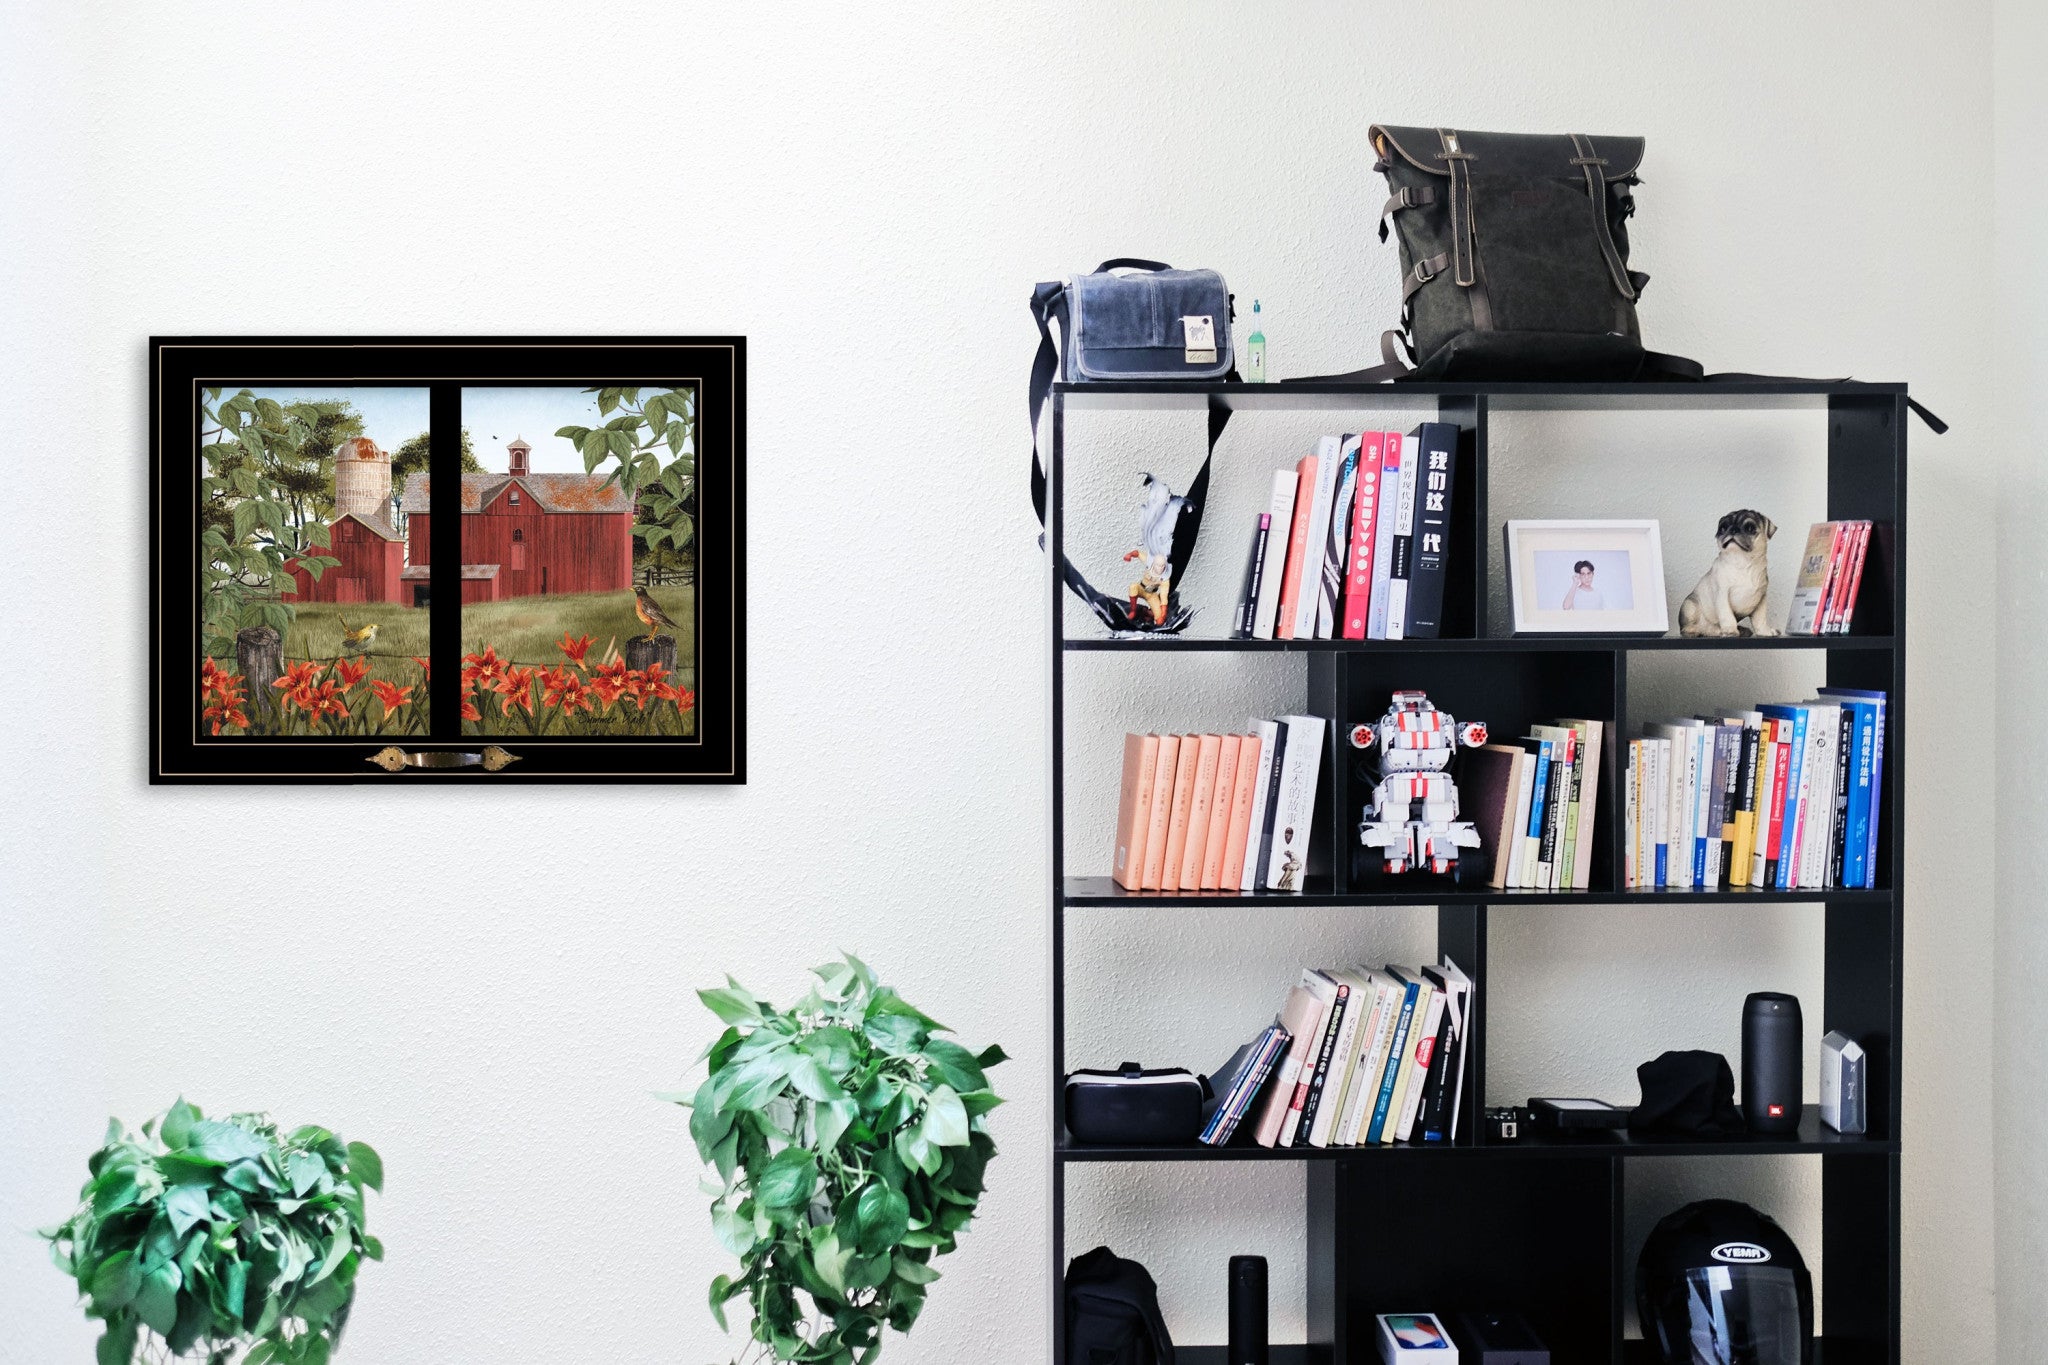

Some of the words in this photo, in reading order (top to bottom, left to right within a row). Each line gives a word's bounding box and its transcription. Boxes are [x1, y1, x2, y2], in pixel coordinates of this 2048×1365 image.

[1336, 488, 1348, 537] ILLUSIONS
[1382, 475, 1394, 515] NAOTO
[1423, 451, 1448, 553] 我们这一代
[1378, 518, 1391, 582] FUKASAWA
[1723, 1247, 1761, 1258] YEMA
